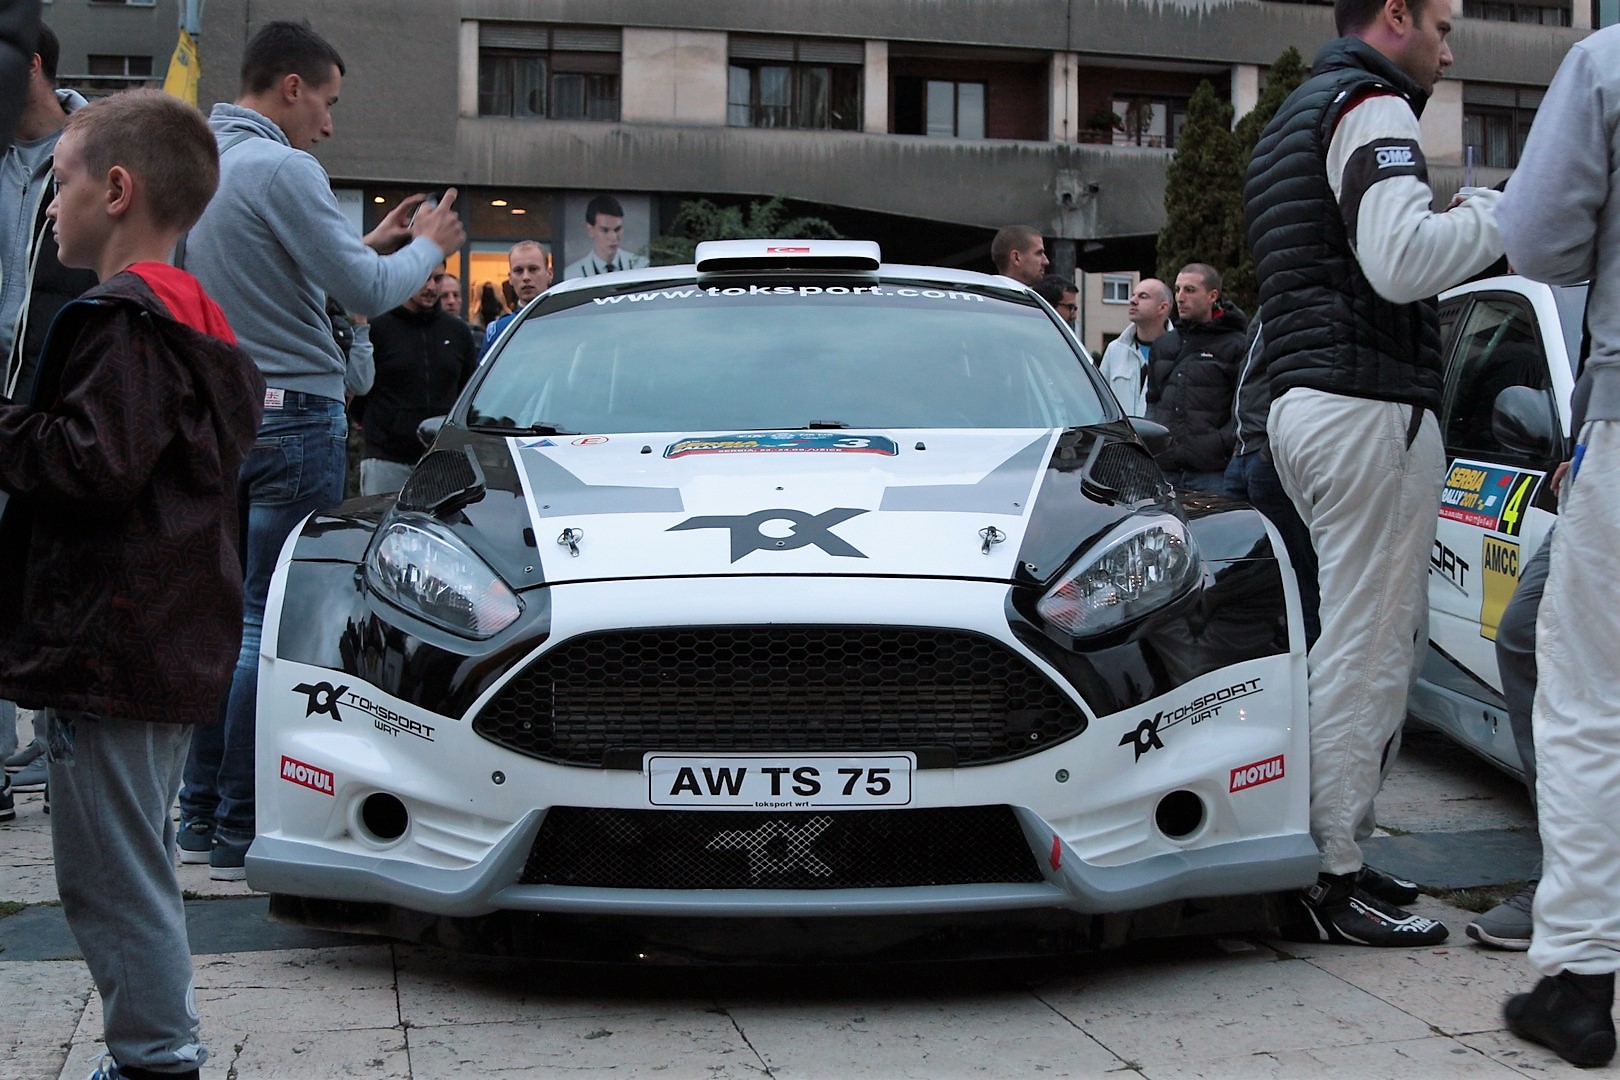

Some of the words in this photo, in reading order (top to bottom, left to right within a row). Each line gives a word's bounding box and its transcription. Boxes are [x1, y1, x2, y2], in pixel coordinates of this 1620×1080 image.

[1376, 149, 1413, 165] OMP
[594, 284, 984, 305] www.toksport.com
[833, 438, 870, 448] 3
[1446, 466, 1487, 492] SERBIA
[1502, 475, 1532, 535] 4
[1485, 542, 1517, 578] AMCC
[1191, 706, 1222, 725] WRT
[374, 719, 400, 737] WRT
[282, 760, 332, 791] MOTUL
[669, 767, 747, 796] AW
[761, 767, 821, 796] TS
[837, 768, 891, 796] 75
[1232, 759, 1283, 788] MOTUL
[755, 801, 793, 809] toksport
